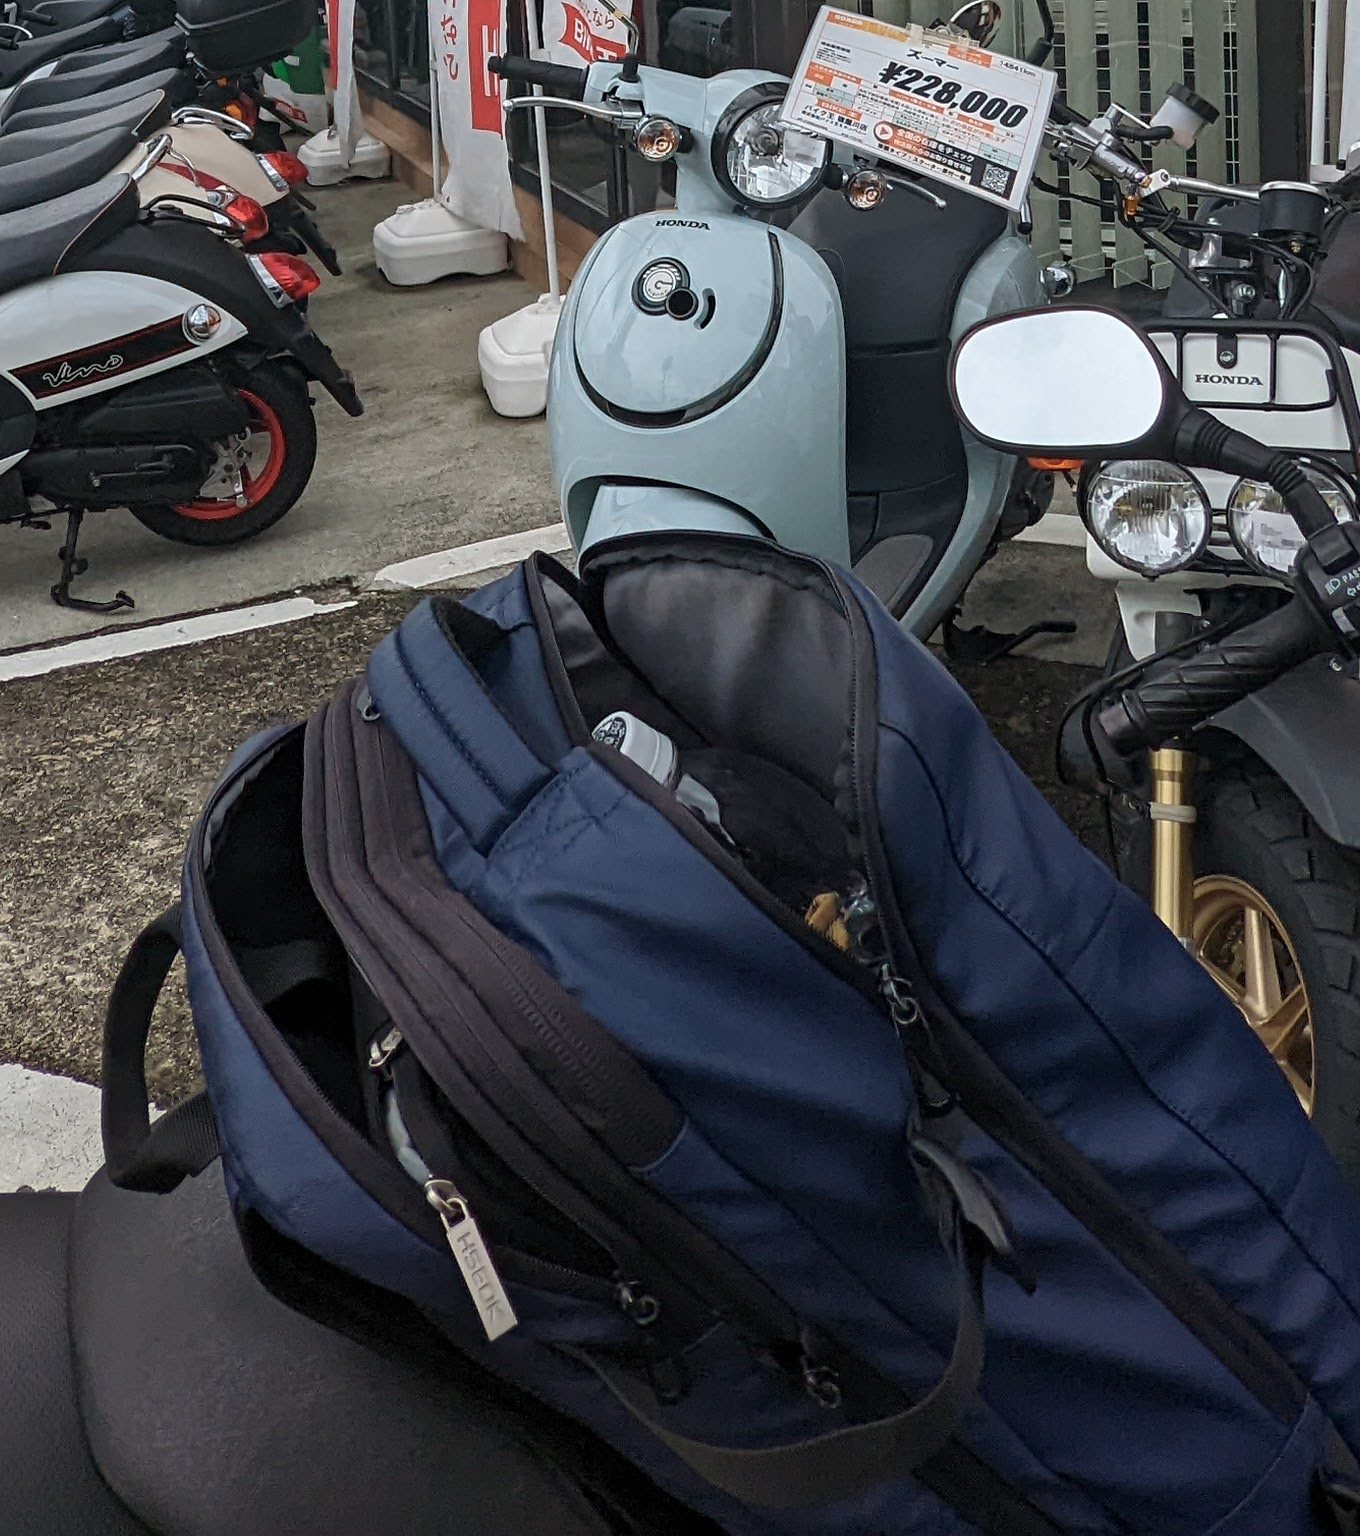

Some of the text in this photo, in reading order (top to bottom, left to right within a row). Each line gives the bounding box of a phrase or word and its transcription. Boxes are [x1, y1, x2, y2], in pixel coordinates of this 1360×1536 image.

[907, 48, 960, 71] ズーマー
[878, 61, 1029, 128] ¥228,000
[656, 220, 711, 231] HONDA
[43, 355, 124, 388] Vino
[1195, 374, 1263, 386] HONDA
